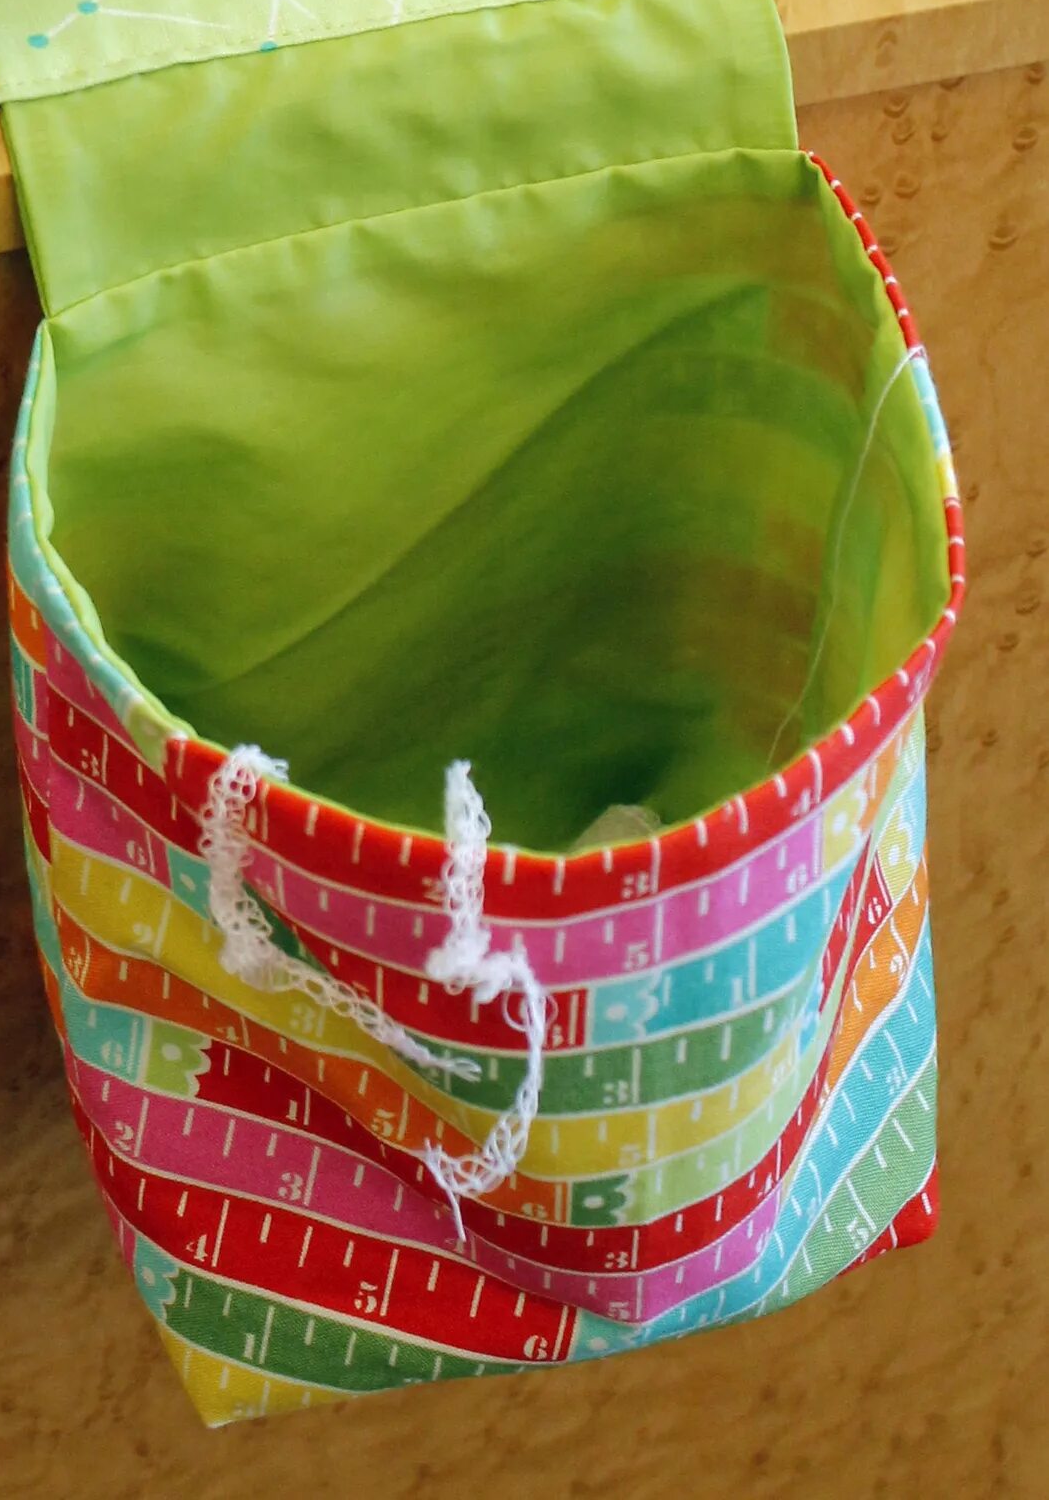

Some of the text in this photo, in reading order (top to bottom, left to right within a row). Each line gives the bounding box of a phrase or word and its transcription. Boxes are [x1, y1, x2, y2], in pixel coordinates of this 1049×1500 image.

[624, 940, 649, 971] 5
[289, 1001, 316, 1034] 3
[603, 1079, 628, 1105] 3
[114, 1121, 135, 1152] 2
[370, 1108, 396, 1138] 5
[277, 1172, 304, 1201] 3
[185, 1234, 208, 1262] 4
[604, 1251, 629, 1269] 3
[353, 1281, 379, 1313] 5
[607, 1301, 631, 1320] 5
[522, 1335, 549, 1360] 6
